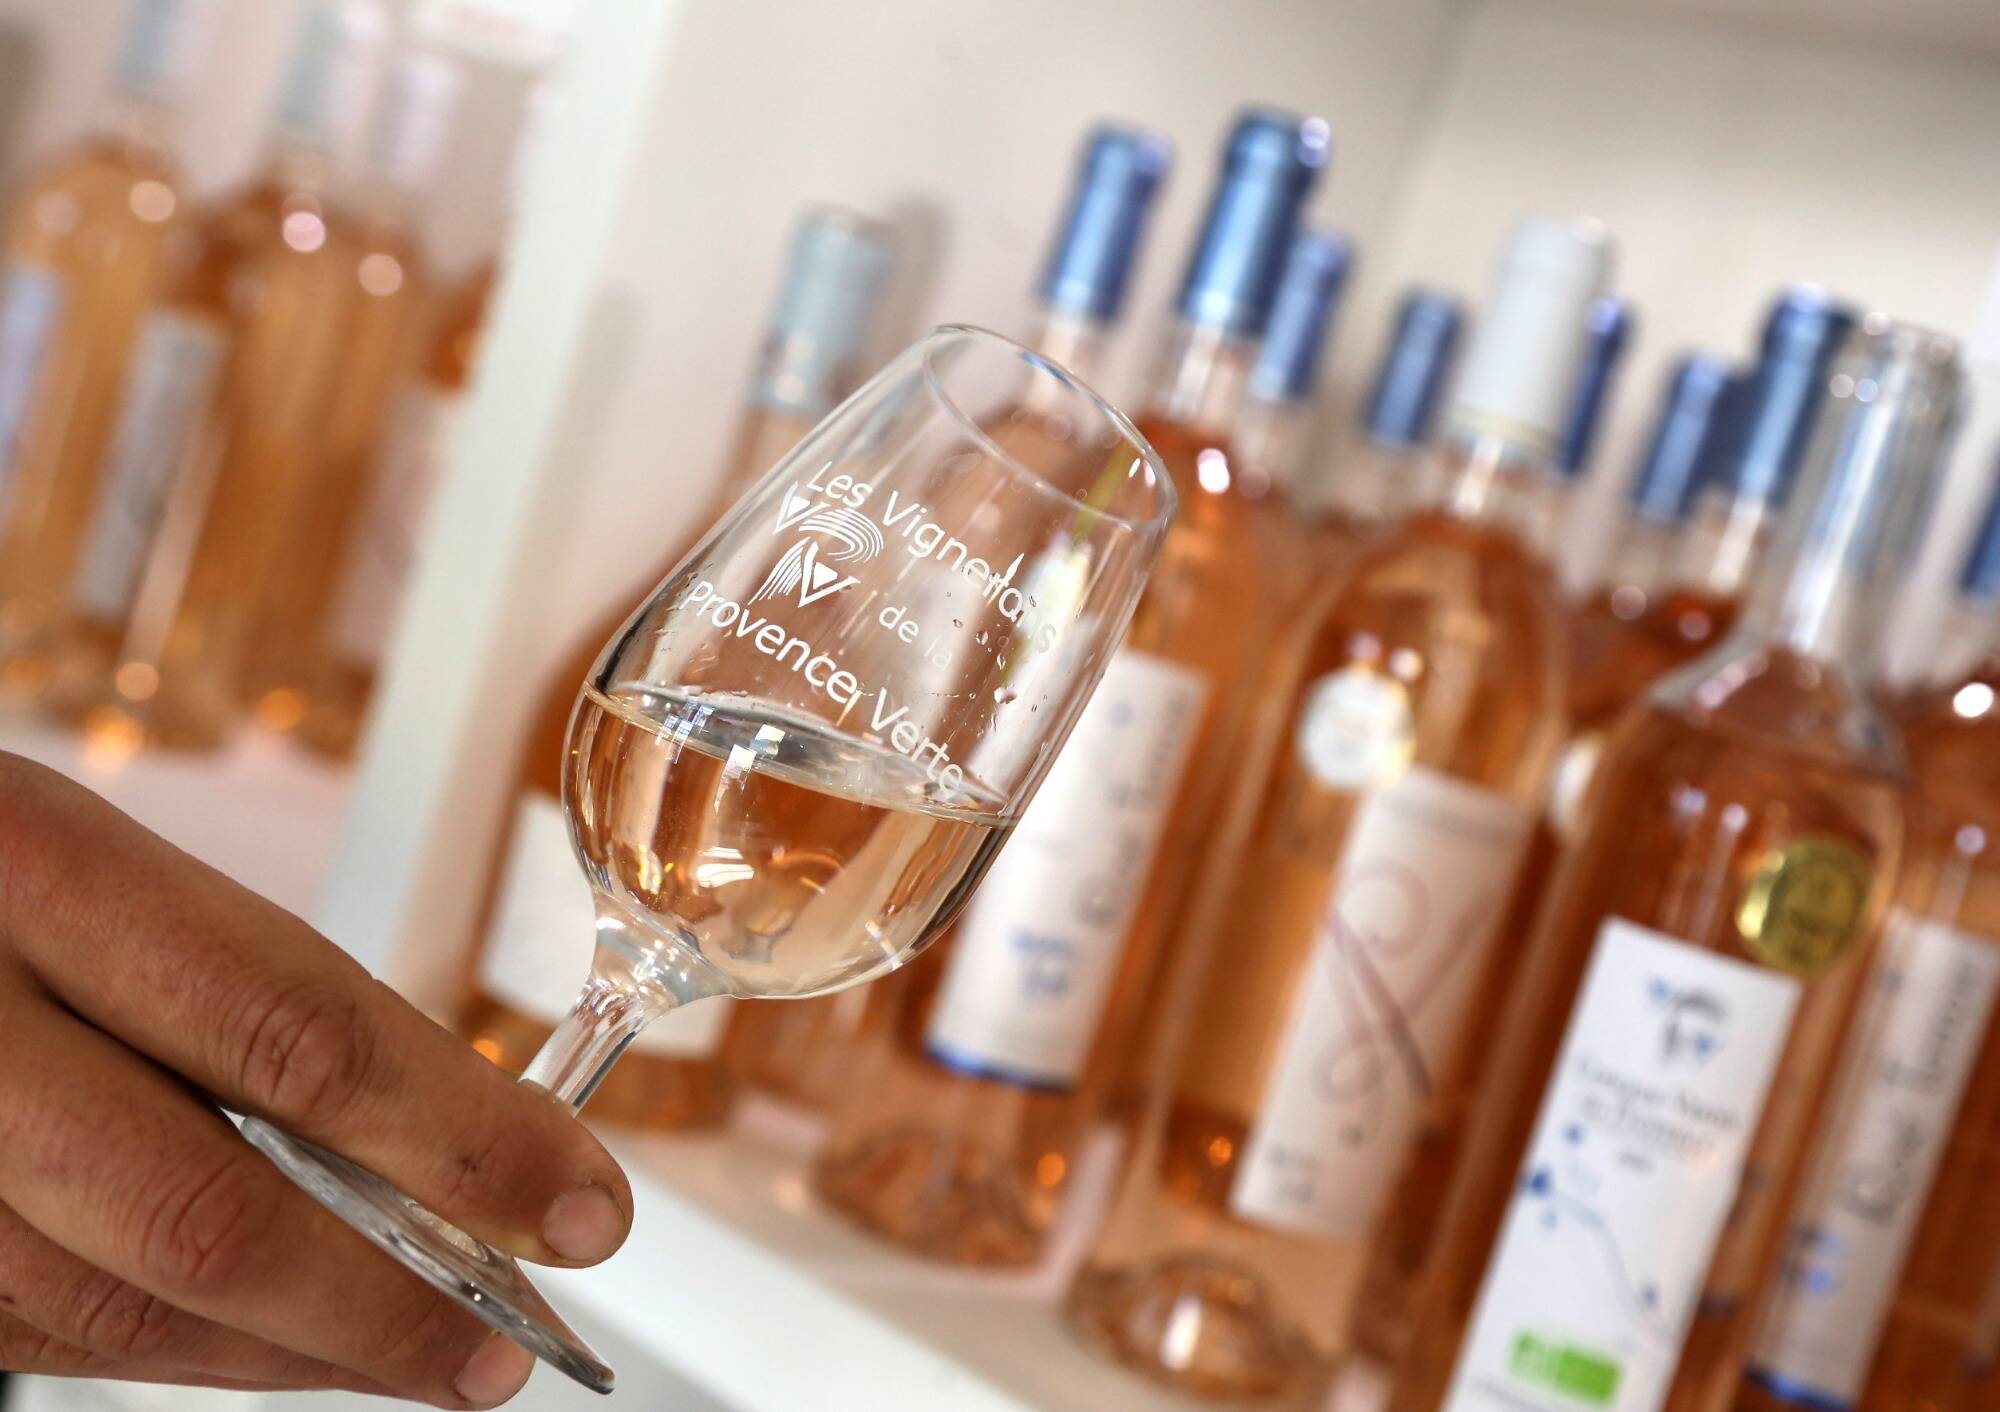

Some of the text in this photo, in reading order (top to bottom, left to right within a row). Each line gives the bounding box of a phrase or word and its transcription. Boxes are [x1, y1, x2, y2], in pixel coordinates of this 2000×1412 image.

[807, 461, 873, 508] Les
[878, 604, 953, 671] de la
[679, 580, 963, 798] Provence Verte
